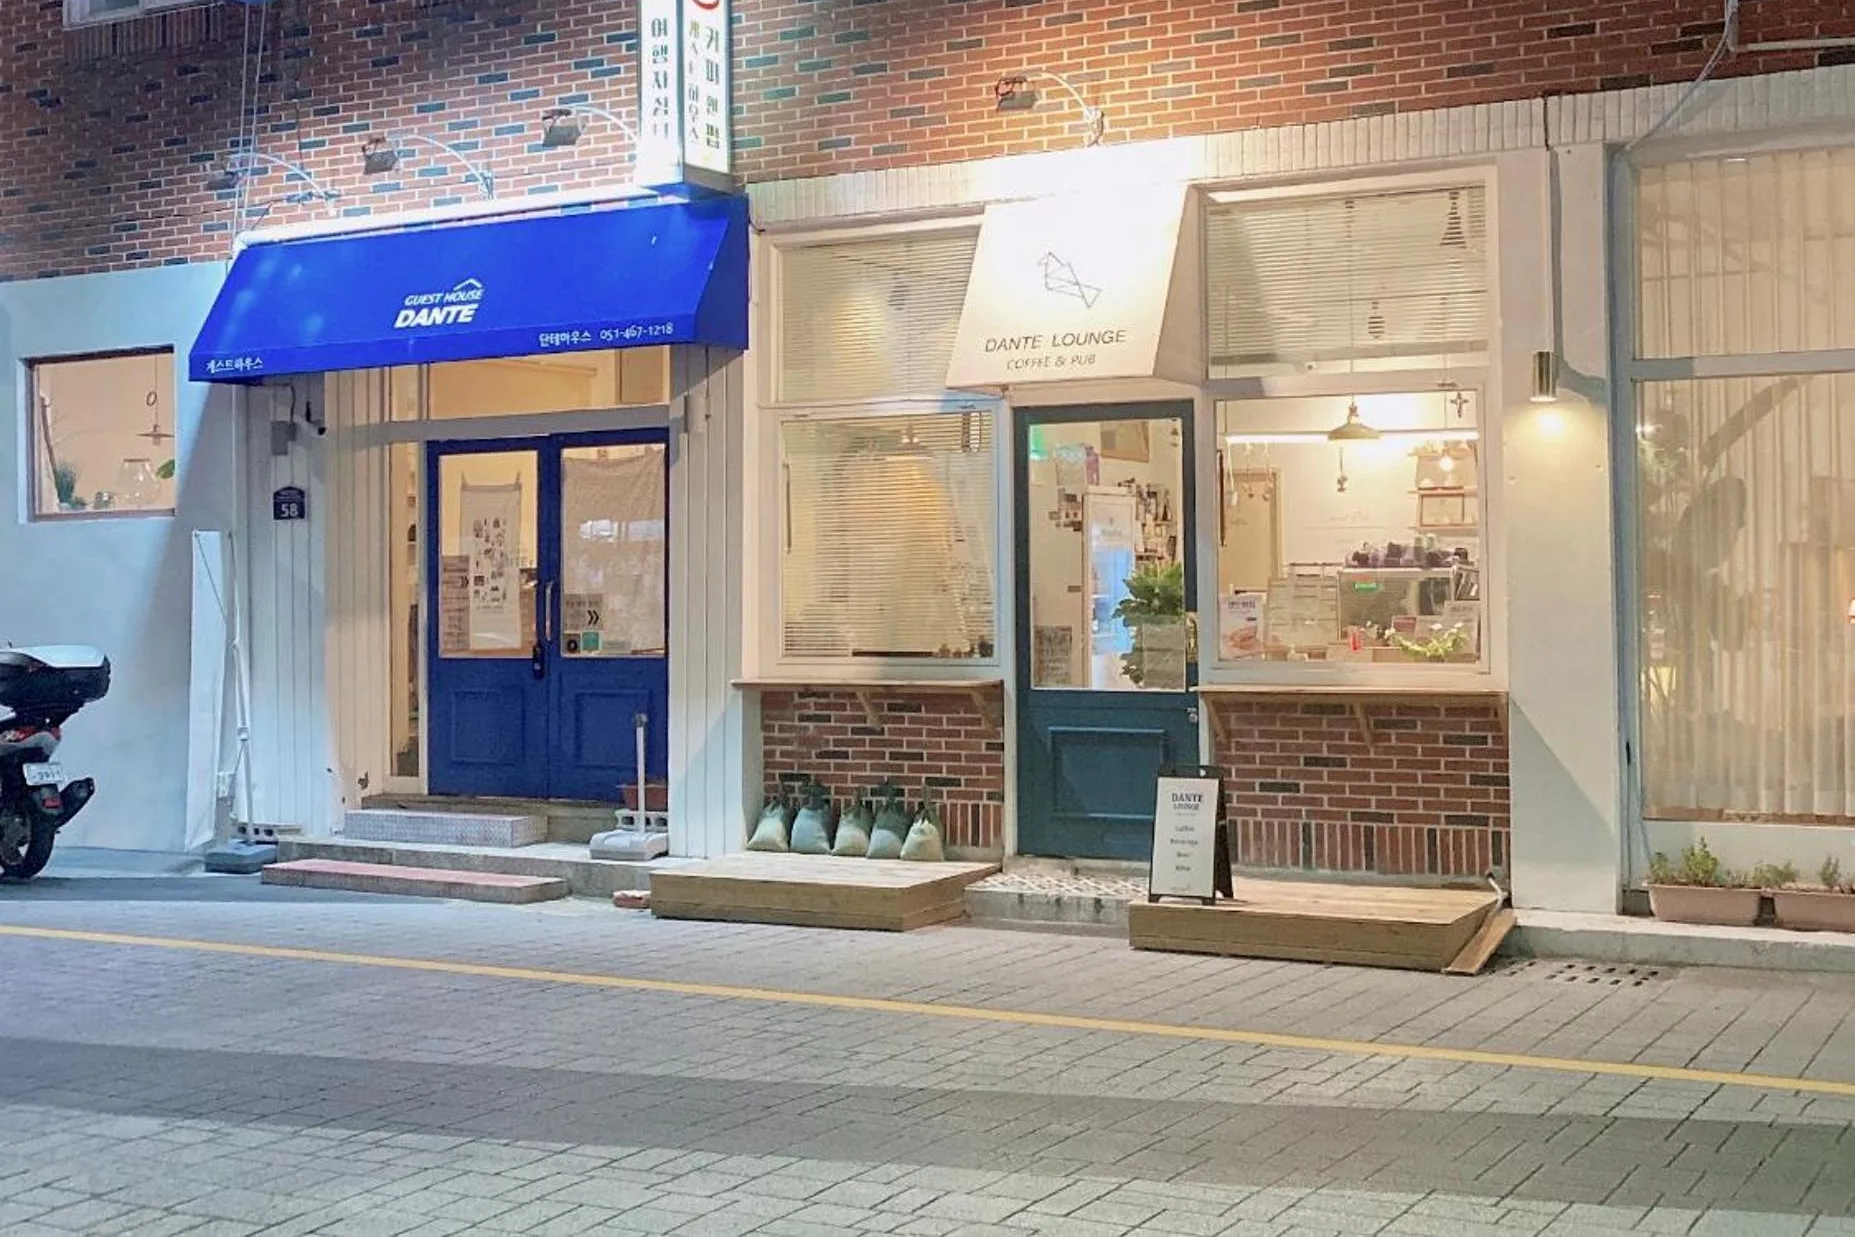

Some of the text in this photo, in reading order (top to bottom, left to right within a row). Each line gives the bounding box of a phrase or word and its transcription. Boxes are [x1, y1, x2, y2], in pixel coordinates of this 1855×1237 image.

[404, 288, 484, 306] GUEST HOUSE
[394, 303, 479, 328] DANTE
[538, 322, 674, 347] 단테하우스 051-467-1218
[985, 329, 1127, 352] DANTE LOUNGE
[206, 356, 264, 374] 게스트하우스
[1006, 354, 1096, 371] COFFEE & PUB
[281, 503, 298, 517] 58
